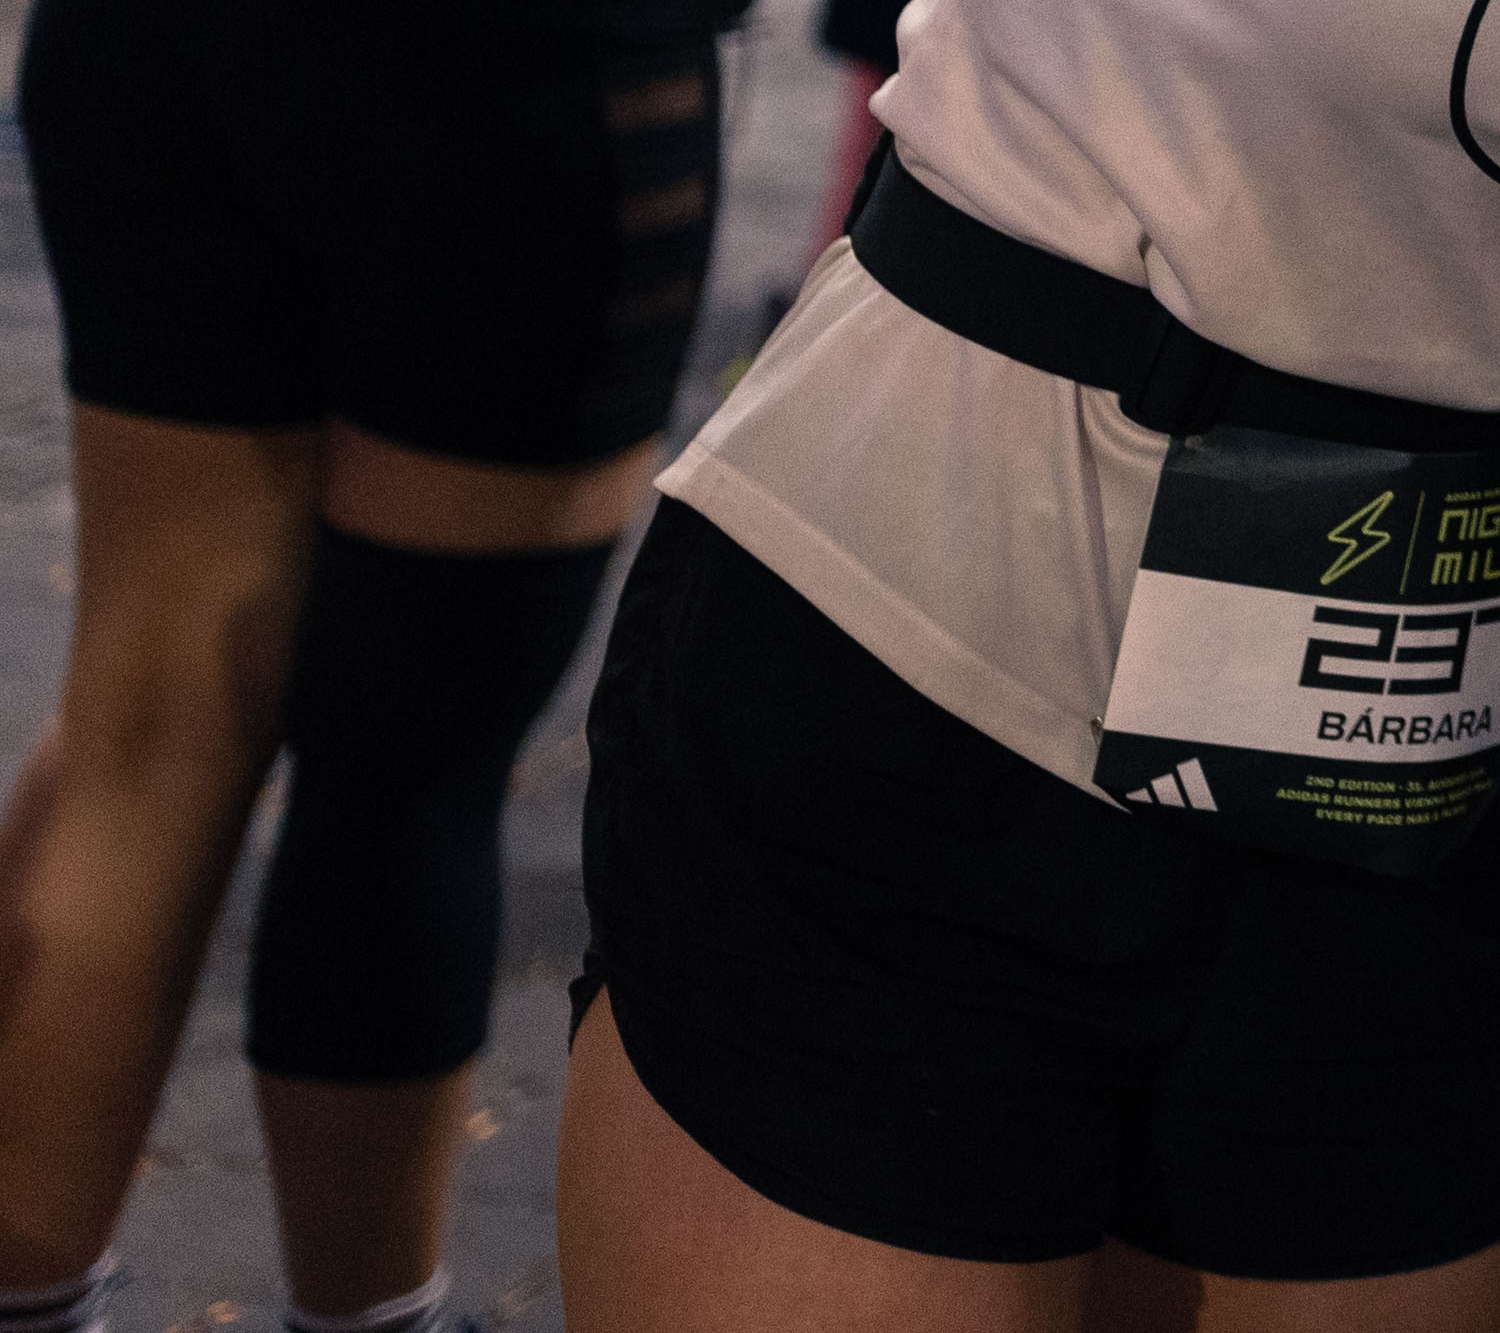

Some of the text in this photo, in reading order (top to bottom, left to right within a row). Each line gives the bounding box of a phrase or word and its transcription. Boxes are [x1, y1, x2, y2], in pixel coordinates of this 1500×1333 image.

[1317, 706, 1491, 745] BÁRBARA
[1305, 774, 1335, 789] 2ND
[1337, 778, 1396, 793] EDITION
[1275, 787, 1331, 805] ADIDAS
[1333, 794, 1401, 810] RUNNERS
[1315, 808, 1364, 824] EVERY
[1366, 812, 1404, 826] PACE
